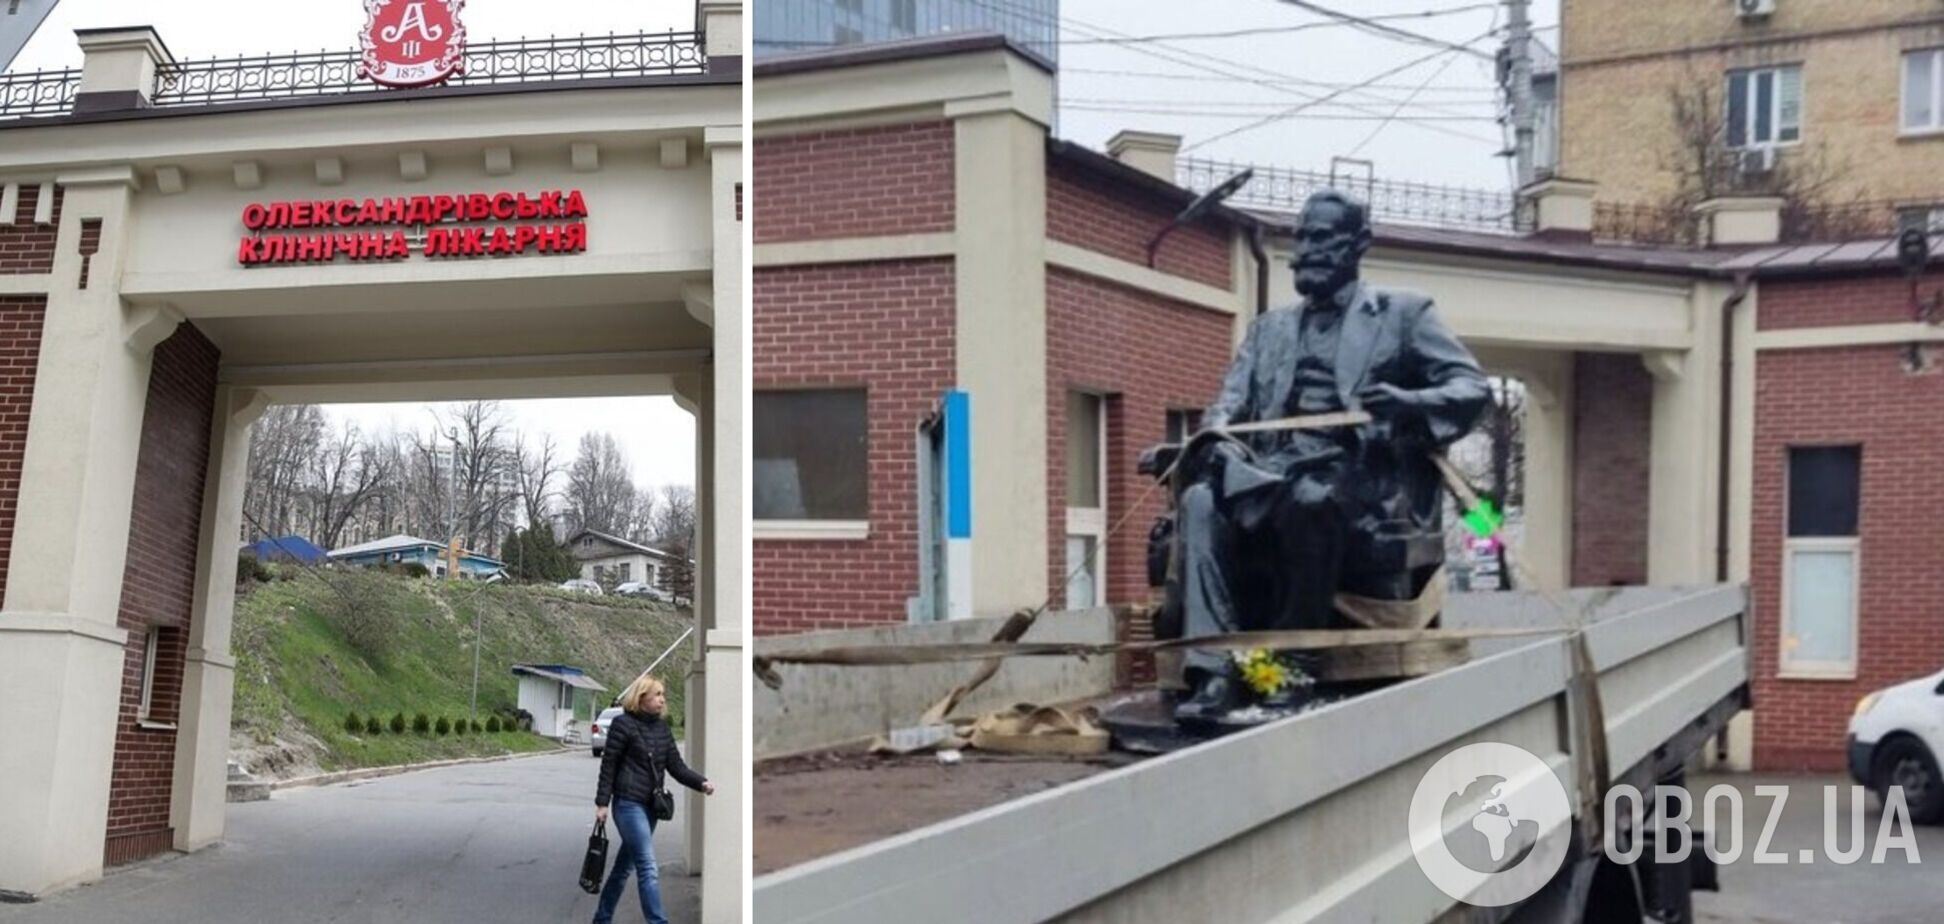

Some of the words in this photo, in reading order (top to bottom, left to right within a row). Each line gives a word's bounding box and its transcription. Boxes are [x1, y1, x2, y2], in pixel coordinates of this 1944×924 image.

[395, 66, 426, 79] 1875
[242, 190, 588, 230] ОЛЕКСАНДРІВСЬКА
[238, 231, 410, 264] КЛІНІЧНА
[424, 223, 587, 257] ЛІКАРНЯ
